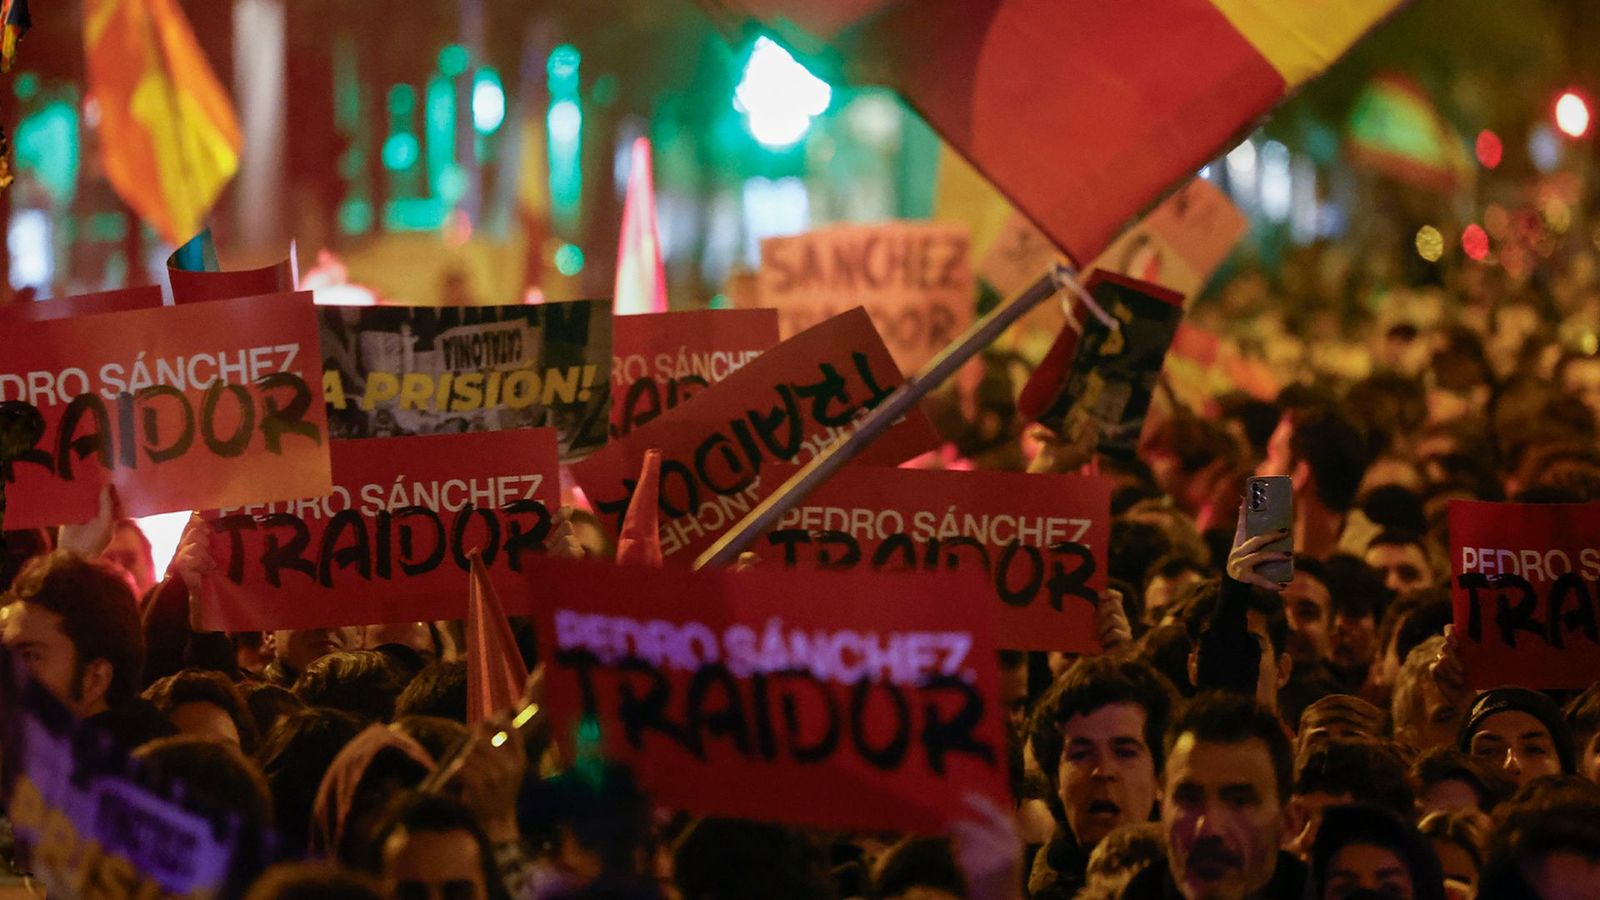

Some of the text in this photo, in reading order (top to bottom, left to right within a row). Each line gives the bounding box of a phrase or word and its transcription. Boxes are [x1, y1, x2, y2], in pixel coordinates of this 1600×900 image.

[99, 344, 303, 400] SÁNCHEZ
[362, 358, 598, 413] PRISIÓN!
[361, 474, 545, 517] SÁNCHEZ
[212, 500, 553, 588] TRAIDOR
[776, 505, 1092, 549] PEDRO SÁNCHEZ
[1463, 546, 1573, 582] PEDRO
[554, 608, 977, 685] PEDRO SÁNCHEZ
[553, 649, 997, 776] TRAIDOR
